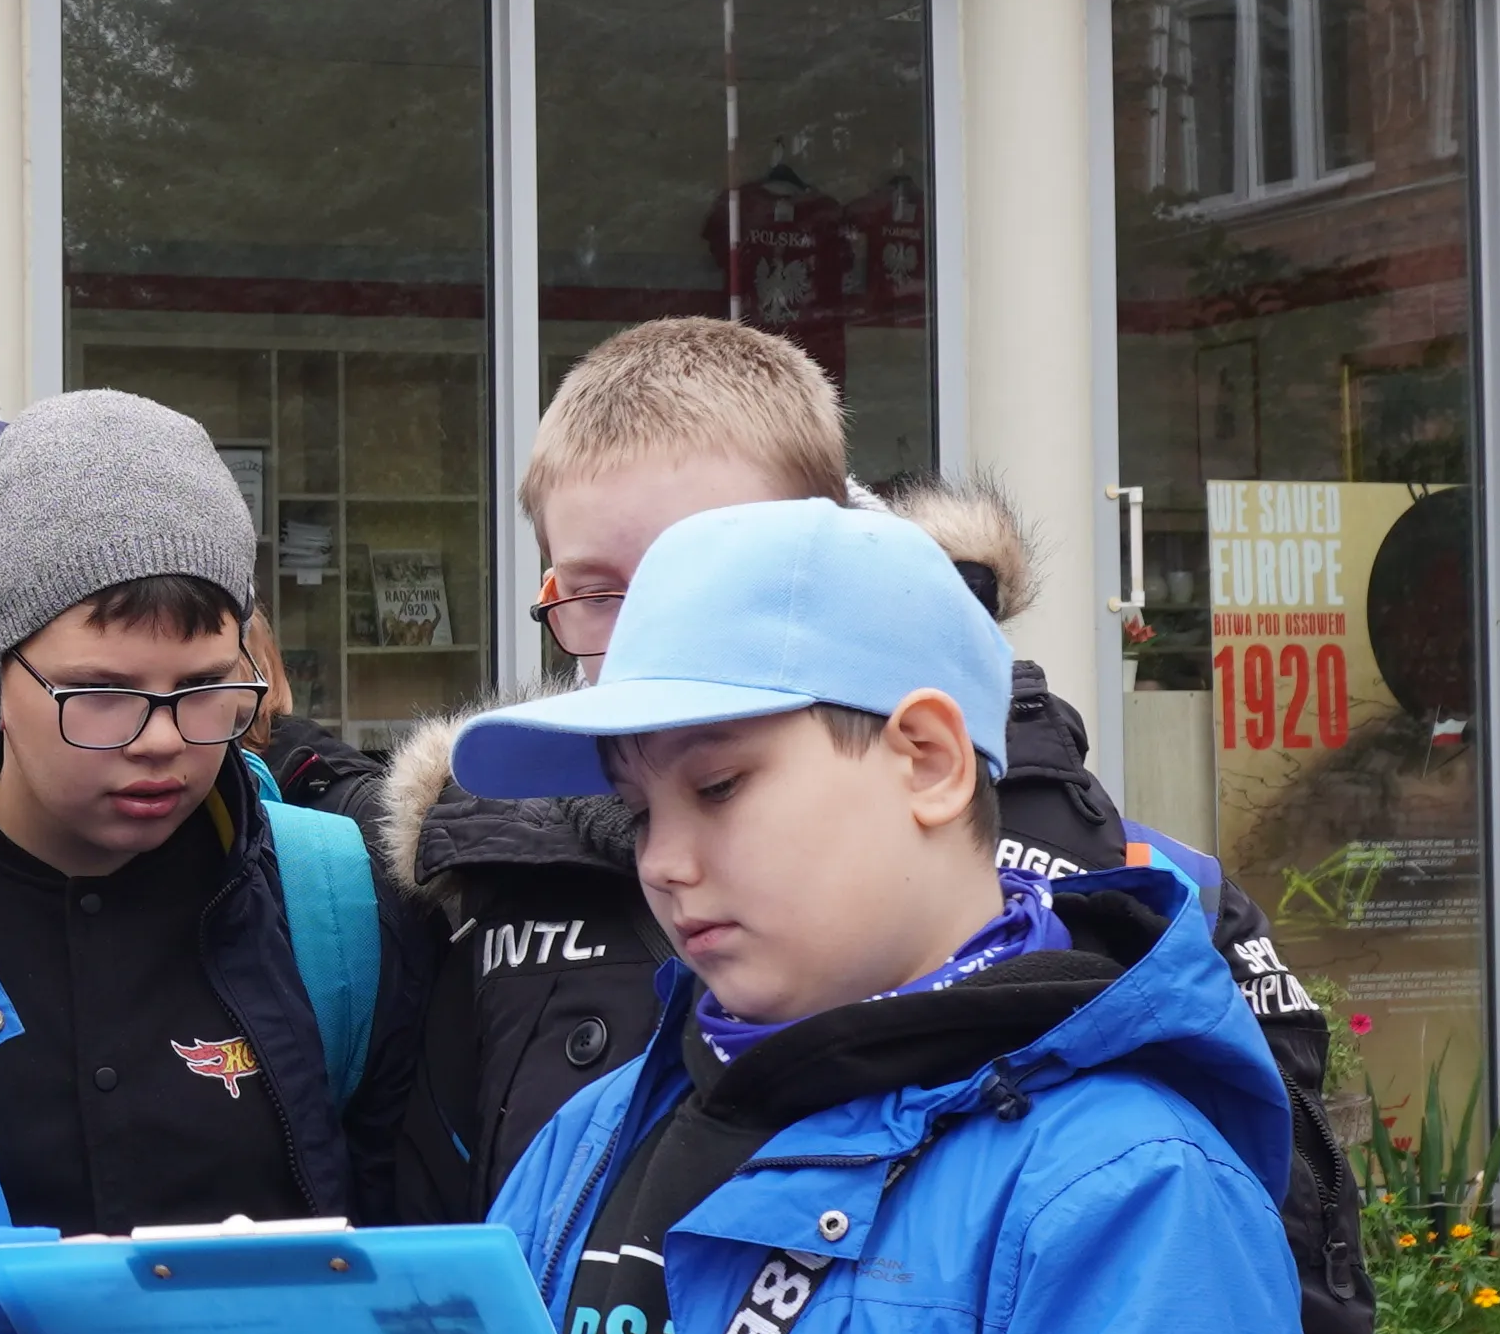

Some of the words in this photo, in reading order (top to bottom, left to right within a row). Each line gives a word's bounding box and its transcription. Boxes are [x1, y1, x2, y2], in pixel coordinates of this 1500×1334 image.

[750, 229, 811, 248] POLSKA
[1208, 483, 1248, 534] WE
[1258, 483, 1340, 534] SAVED
[385, 590, 441, 602] RADZYMIN
[1211, 539, 1344, 606] EUROPE
[1213, 613, 1252, 636] BITWA
[1257, 613, 1280, 636] POD
[1285, 613, 1346, 636] OSSOWEM
[1213, 643, 1349, 751] 1920
[482, 919, 606, 977] INTL.
